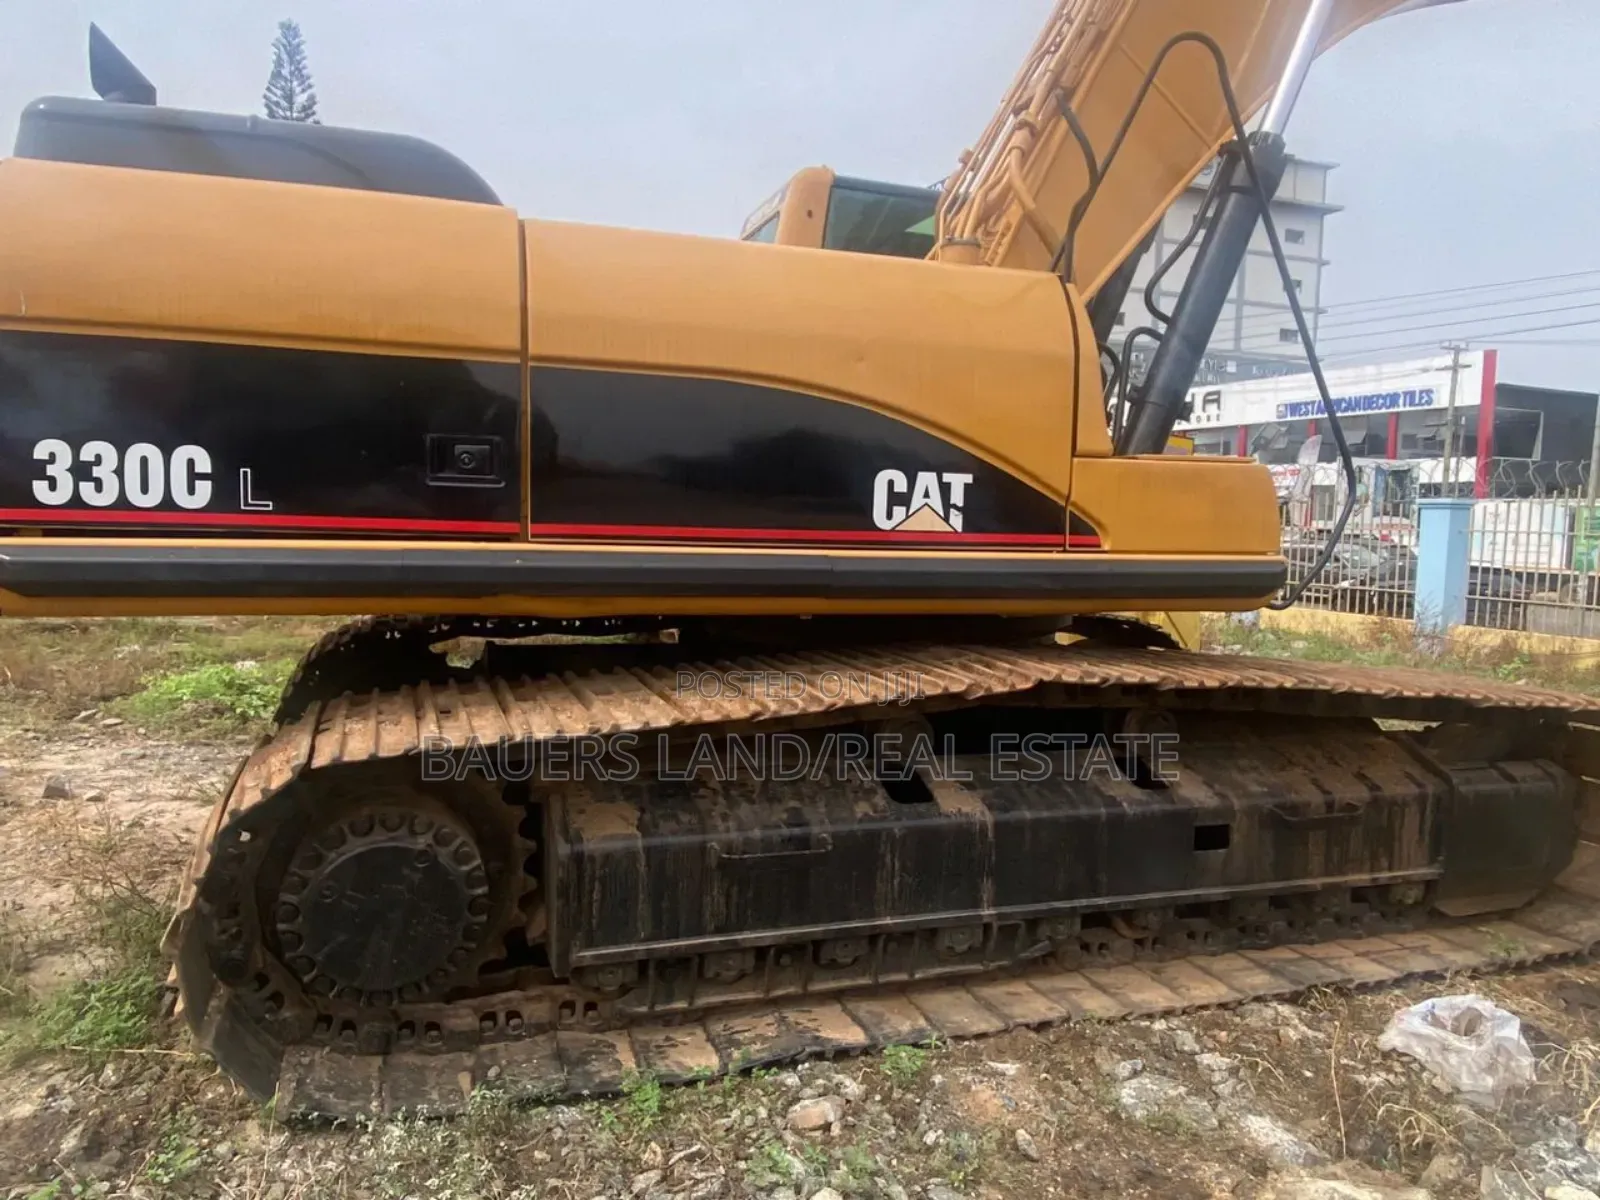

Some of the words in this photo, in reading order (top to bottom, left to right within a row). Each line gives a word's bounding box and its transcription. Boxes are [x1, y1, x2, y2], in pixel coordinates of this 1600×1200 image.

[1289, 400, 1316, 418] WEST
[1362, 391, 1401, 412] DECOR
[1401, 388, 1435, 408] TILES
[32, 438, 213, 510] 330C
[240, 468, 273, 510] L
[872, 468, 973, 533] CAT
